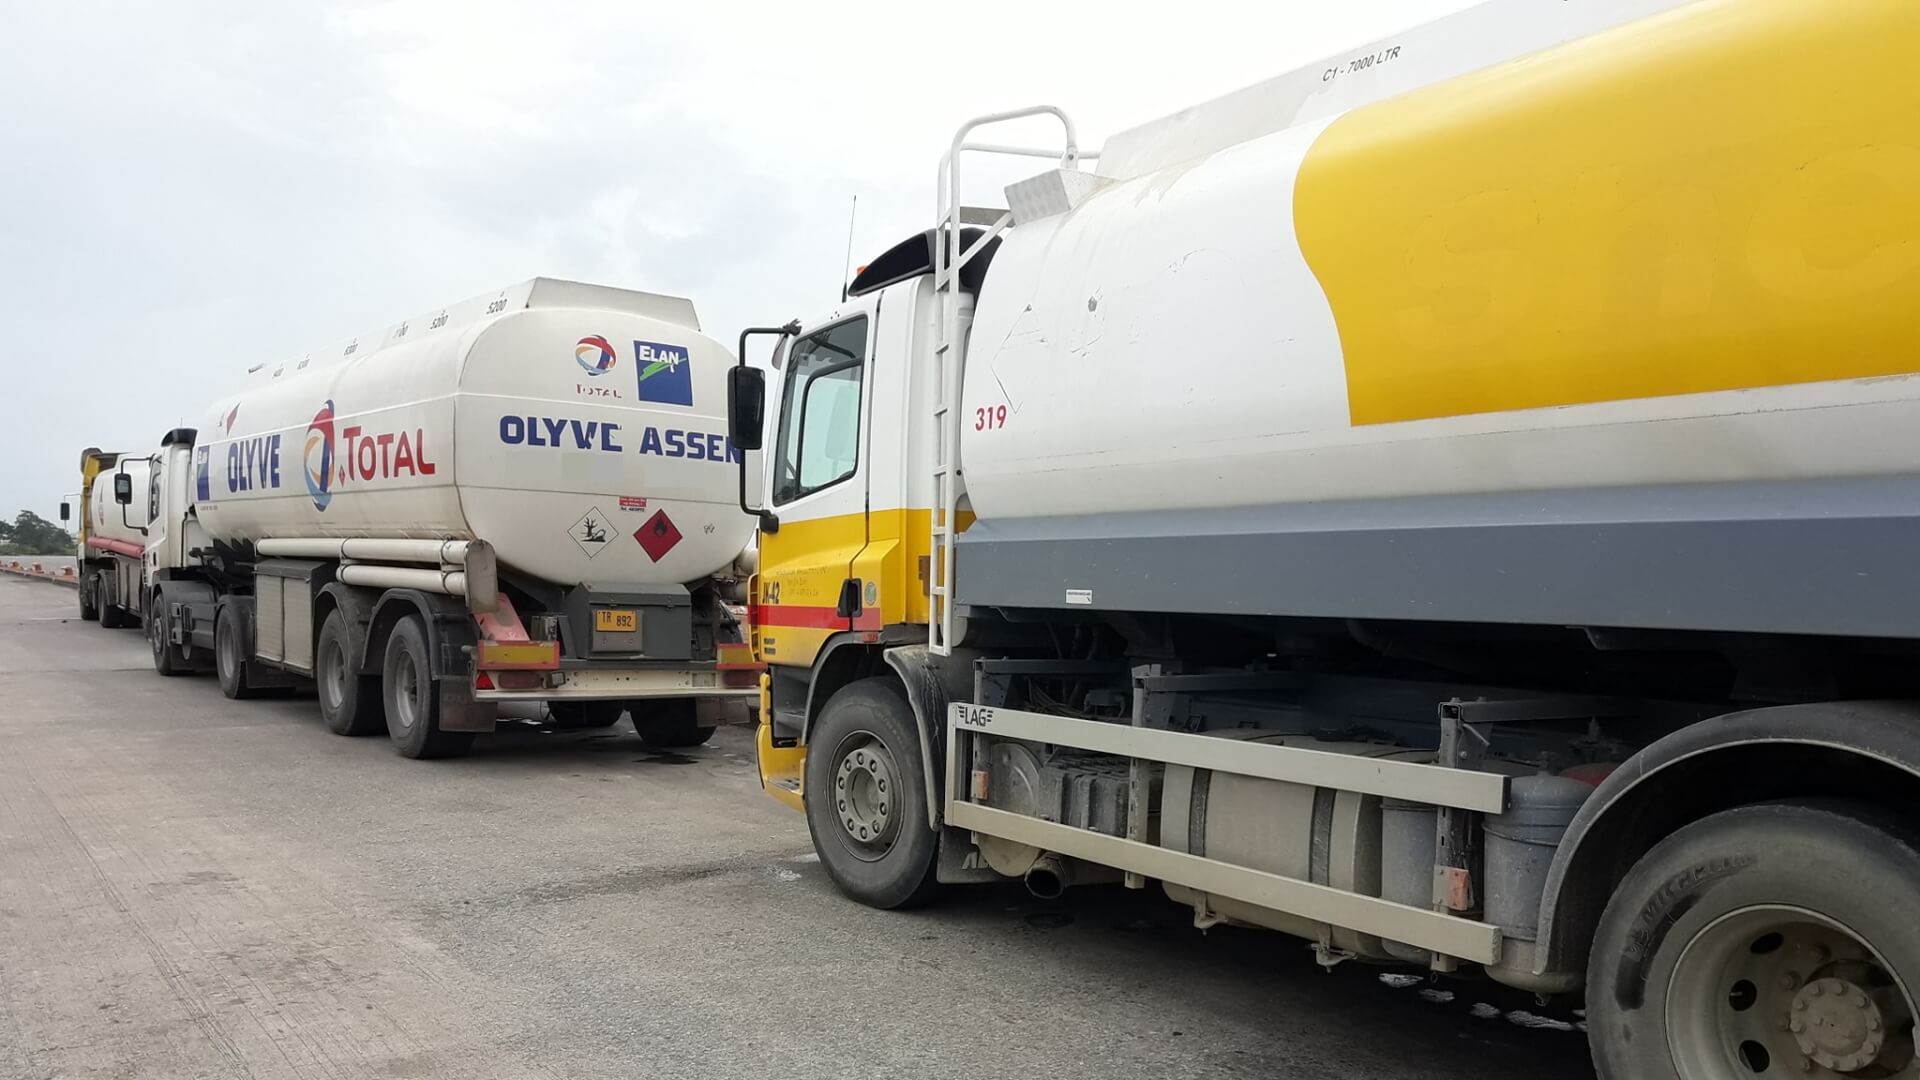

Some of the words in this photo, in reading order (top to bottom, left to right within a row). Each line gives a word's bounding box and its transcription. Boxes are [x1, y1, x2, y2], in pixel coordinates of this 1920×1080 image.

[1322, 67, 1338, 82] C1
[1347, 55, 1375, 74] 7000
[1376, 46, 1401, 64] LTR
[486, 298, 508, 315] 5200
[639, 344, 680, 366] ELAN
[974, 404, 1008, 432] 319
[227, 433, 281, 493] OLYVE
[343, 426, 436, 482] TOTAL
[601, 611, 612, 623] TR
[615, 614, 632, 628] 892
[964, 708, 986, 727] LAG
